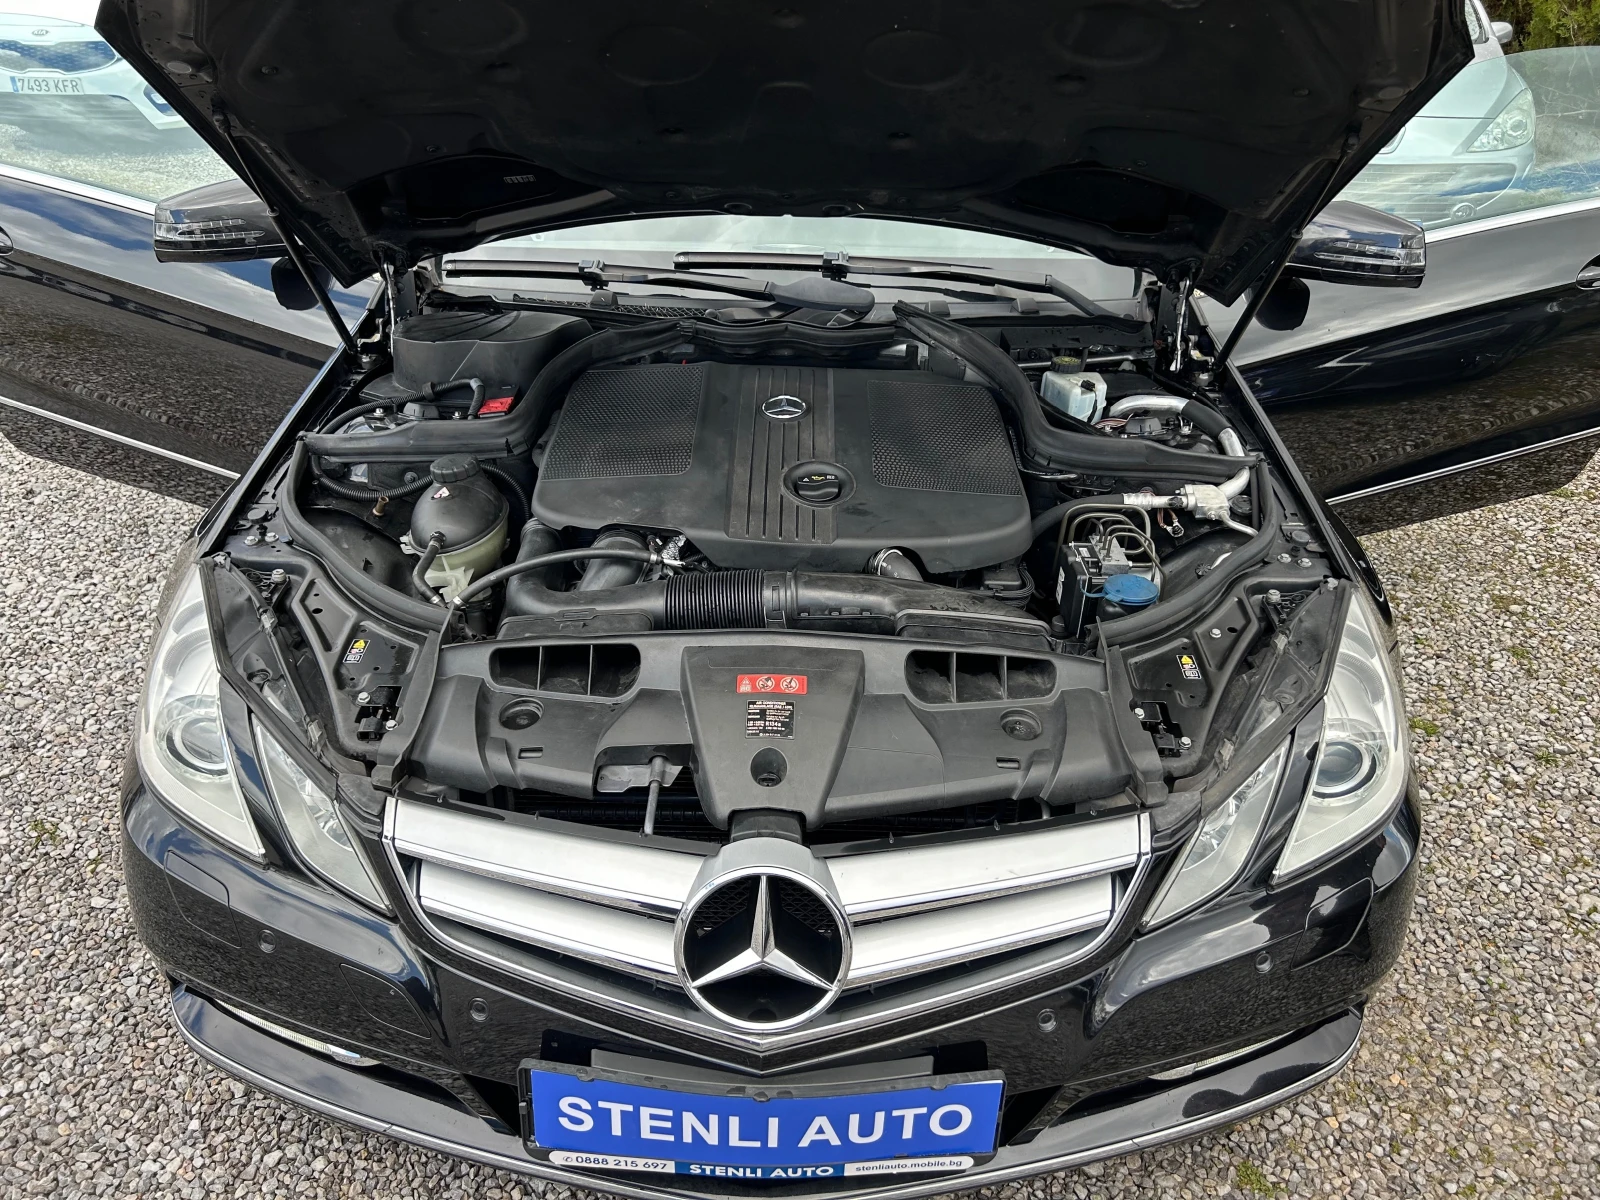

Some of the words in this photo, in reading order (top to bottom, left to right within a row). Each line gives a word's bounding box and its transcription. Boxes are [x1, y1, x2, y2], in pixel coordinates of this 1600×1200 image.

[18, 79, 50, 92] 7493
[53, 79, 80, 93] KFR
[558, 1096, 779, 1148] STENLI
[797, 1104, 973, 1148] AUTO
[575, 1156, 609, 1165] 0888
[613, 1159, 638, 1167] 215
[643, 1161, 667, 1170] 697
[855, 1160, 963, 1172] stenliauto.mobile.bg
[689, 1164, 762, 1177] STENLI
[769, 1166, 834, 1178] AUTO
